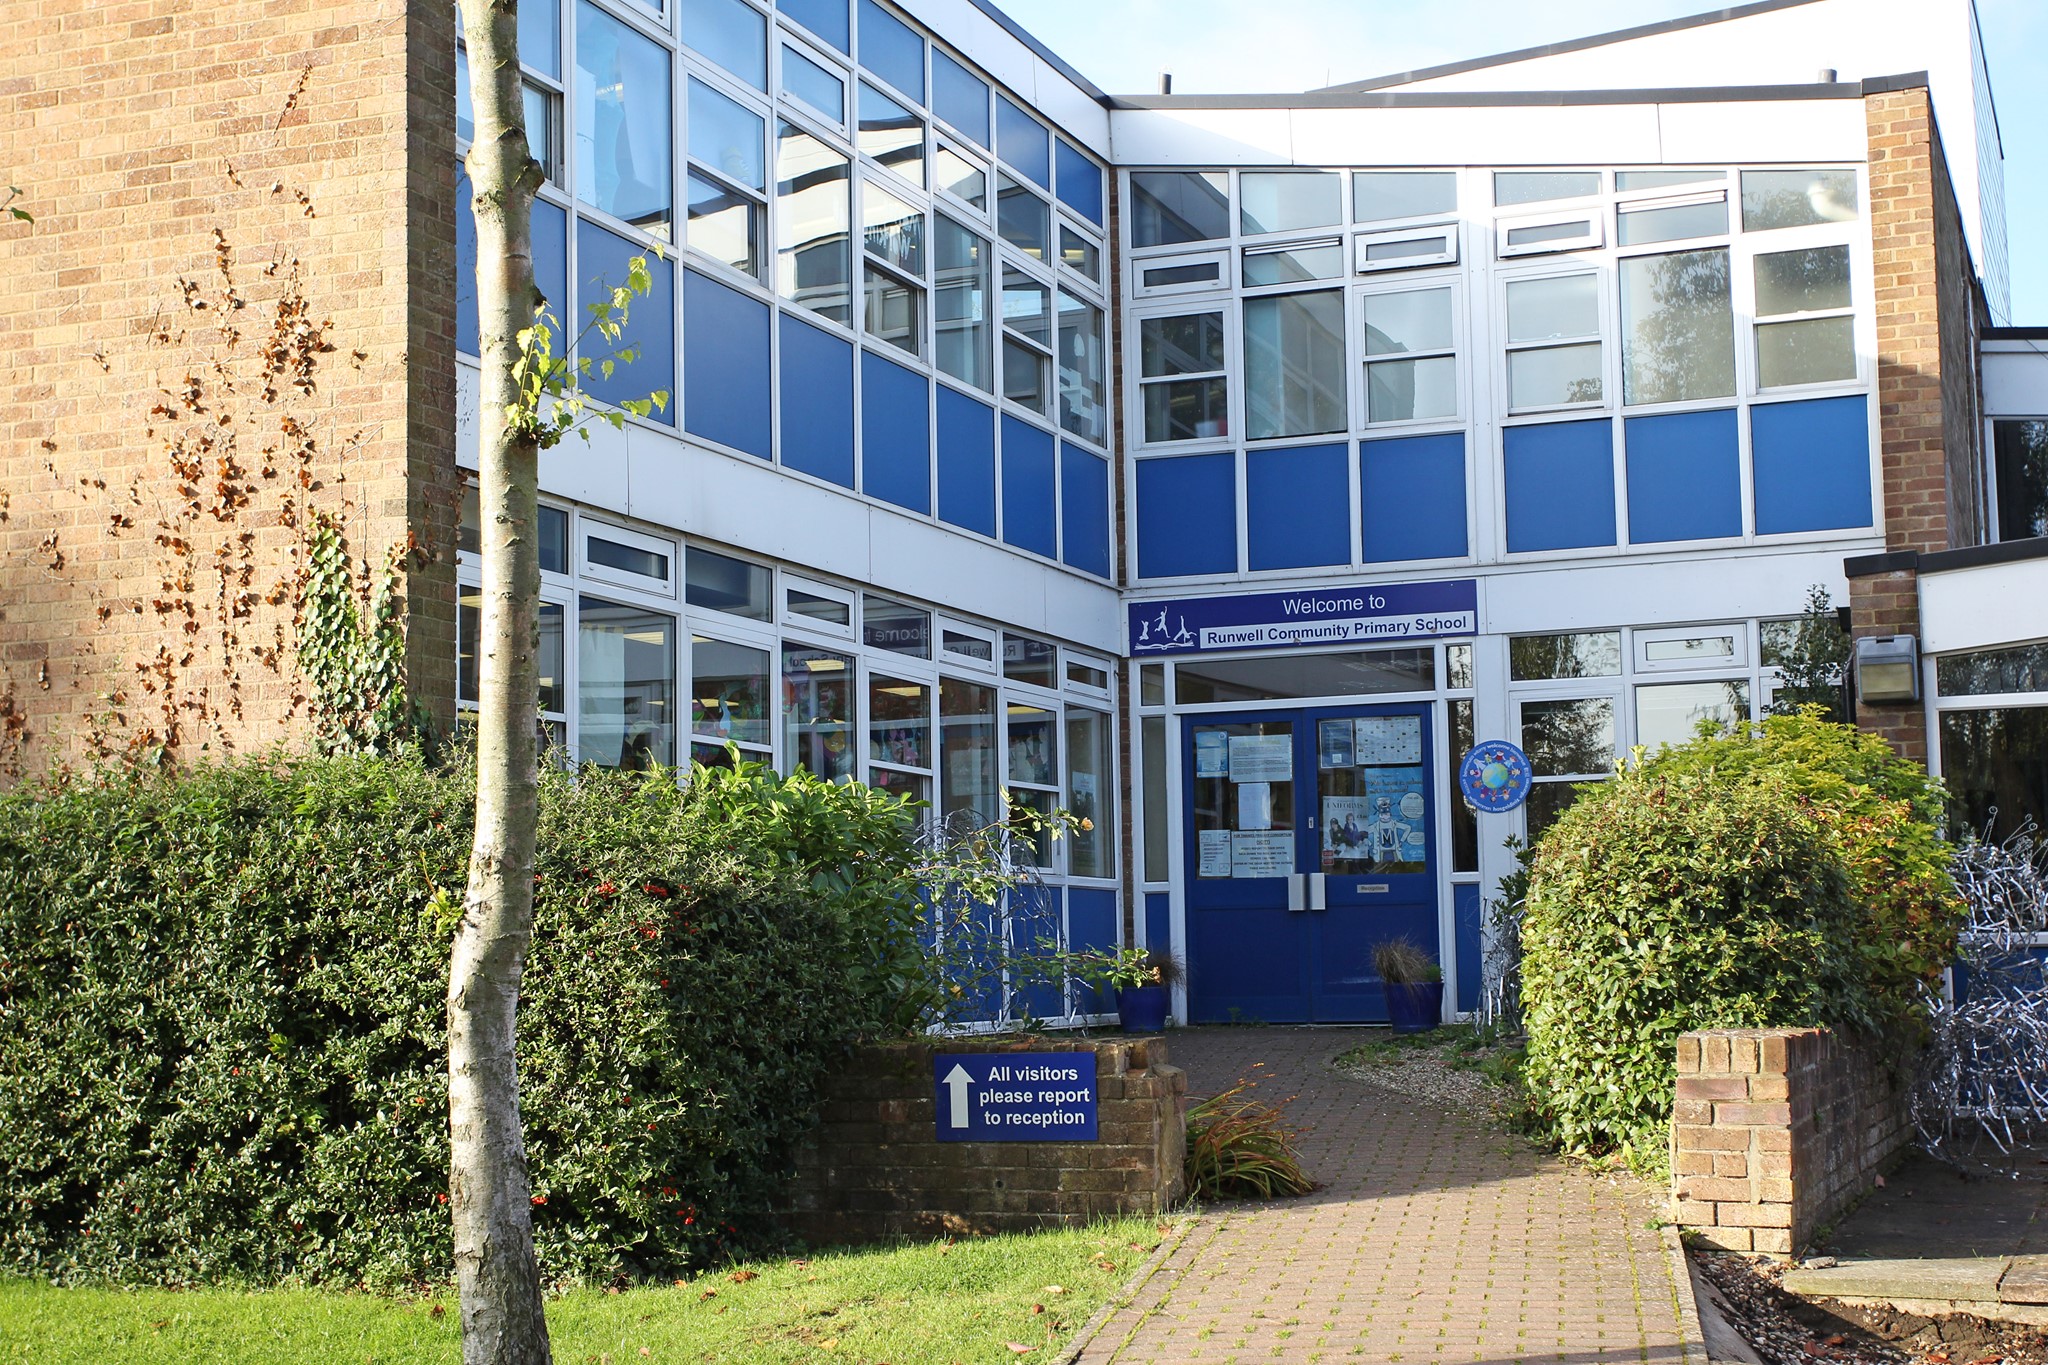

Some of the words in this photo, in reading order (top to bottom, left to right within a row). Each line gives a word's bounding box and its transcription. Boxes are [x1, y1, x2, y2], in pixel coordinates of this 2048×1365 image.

[1283, 597, 1363, 615] Welcome
[1369, 594, 1385, 609] to
[1207, 629, 1263, 644] Runwell
[1268, 624, 1349, 640] Community
[1354, 621, 1410, 635] Primary
[1415, 616, 1466, 631] School
[988, 1066, 1010, 1082] All
[1015, 1065, 1078, 1081] visitors
[980, 1088, 1033, 1107] please
[1038, 1087, 1090, 1106] report
[984, 1110, 1001, 1125] to
[1006, 1109, 1085, 1128] reception
